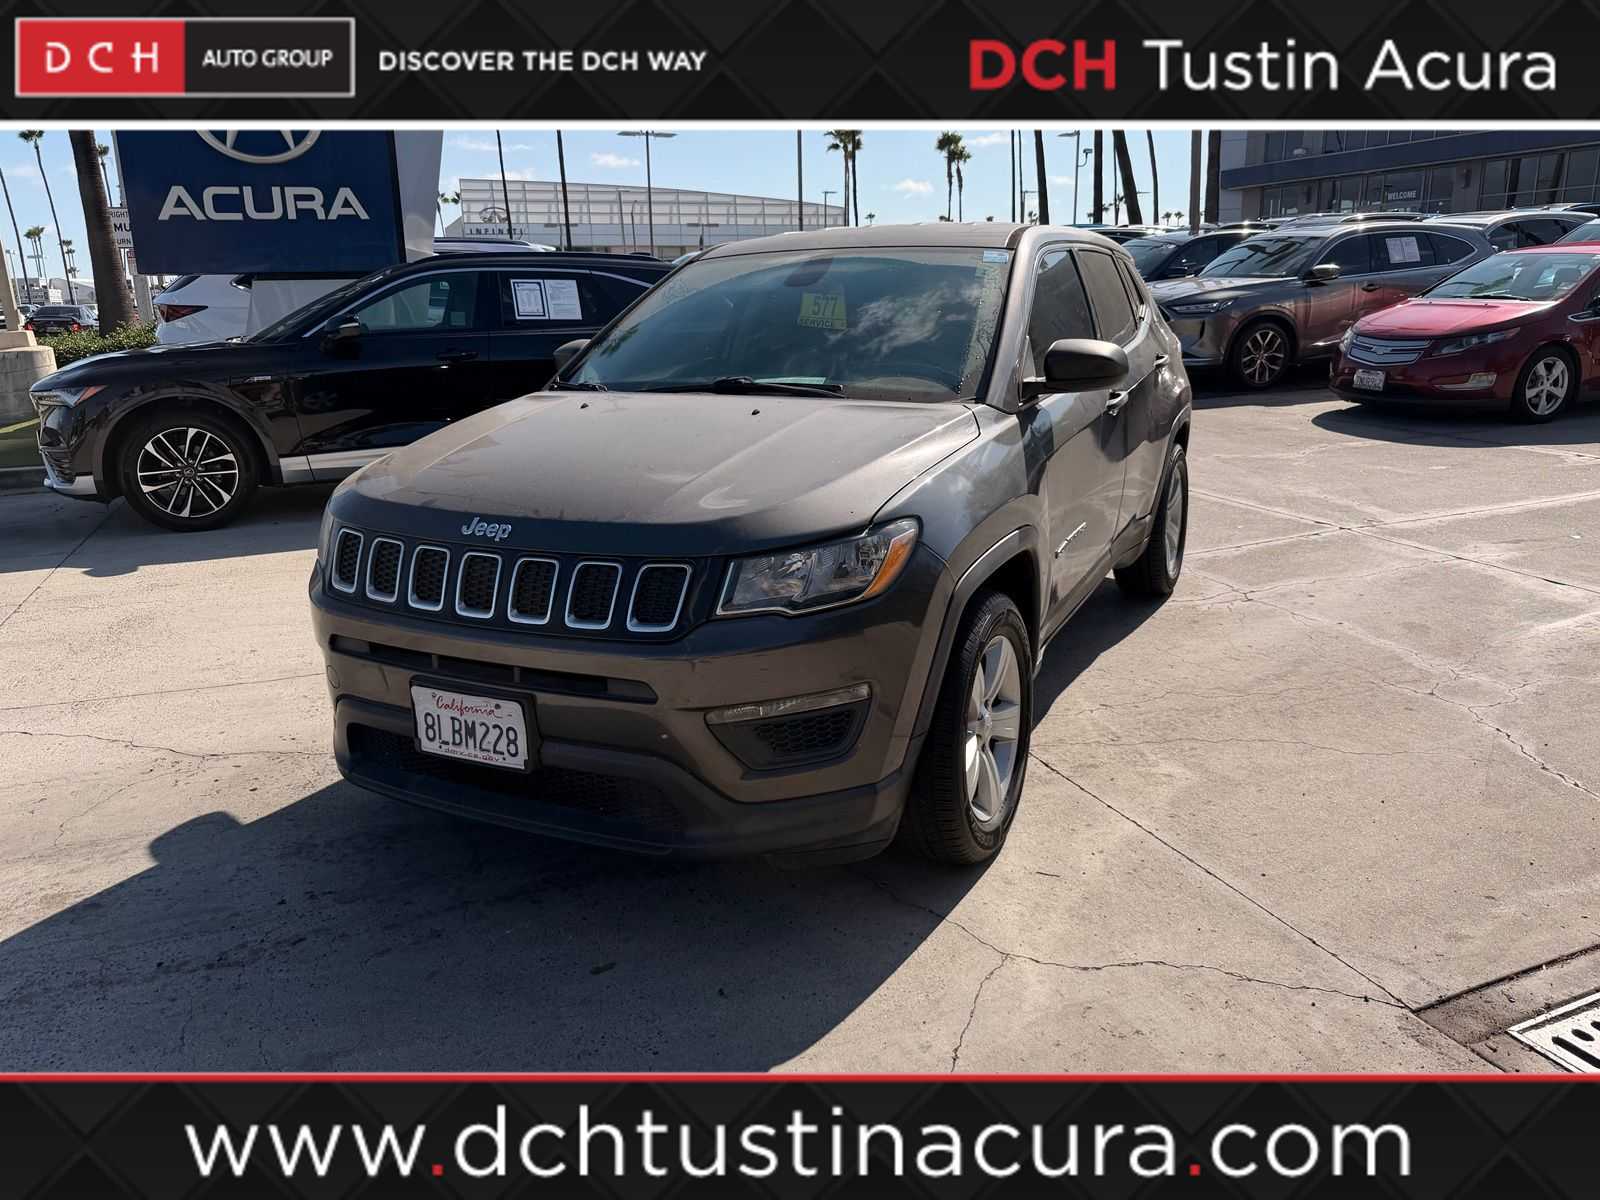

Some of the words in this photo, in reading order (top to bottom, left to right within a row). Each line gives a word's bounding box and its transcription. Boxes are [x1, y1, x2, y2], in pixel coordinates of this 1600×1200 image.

[158, 185, 370, 220] ACURA
[1387, 190, 1417, 200] WELCOME
[461, 516, 512, 541] Jeep
[436, 695, 503, 719] California
[423, 712, 519, 757] 8LBM228
